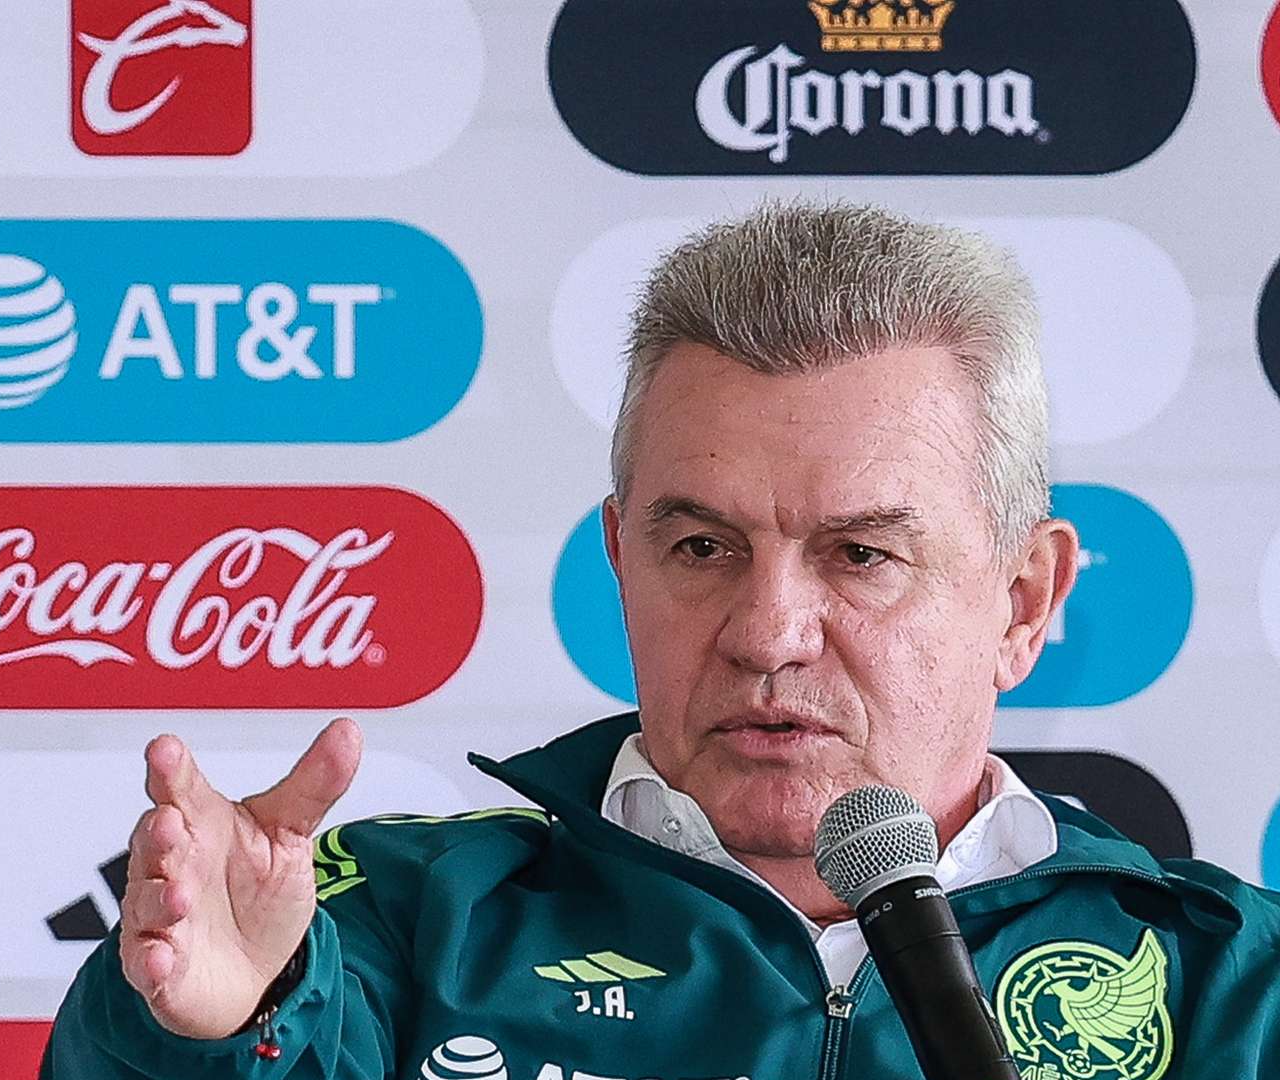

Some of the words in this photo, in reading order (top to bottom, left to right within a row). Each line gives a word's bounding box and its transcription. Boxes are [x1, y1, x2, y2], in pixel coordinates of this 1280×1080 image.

[695, 46, 1036, 164] Corona
[100, 283, 378, 380] AT&T
[574, 985, 635, 1020] J.A.
